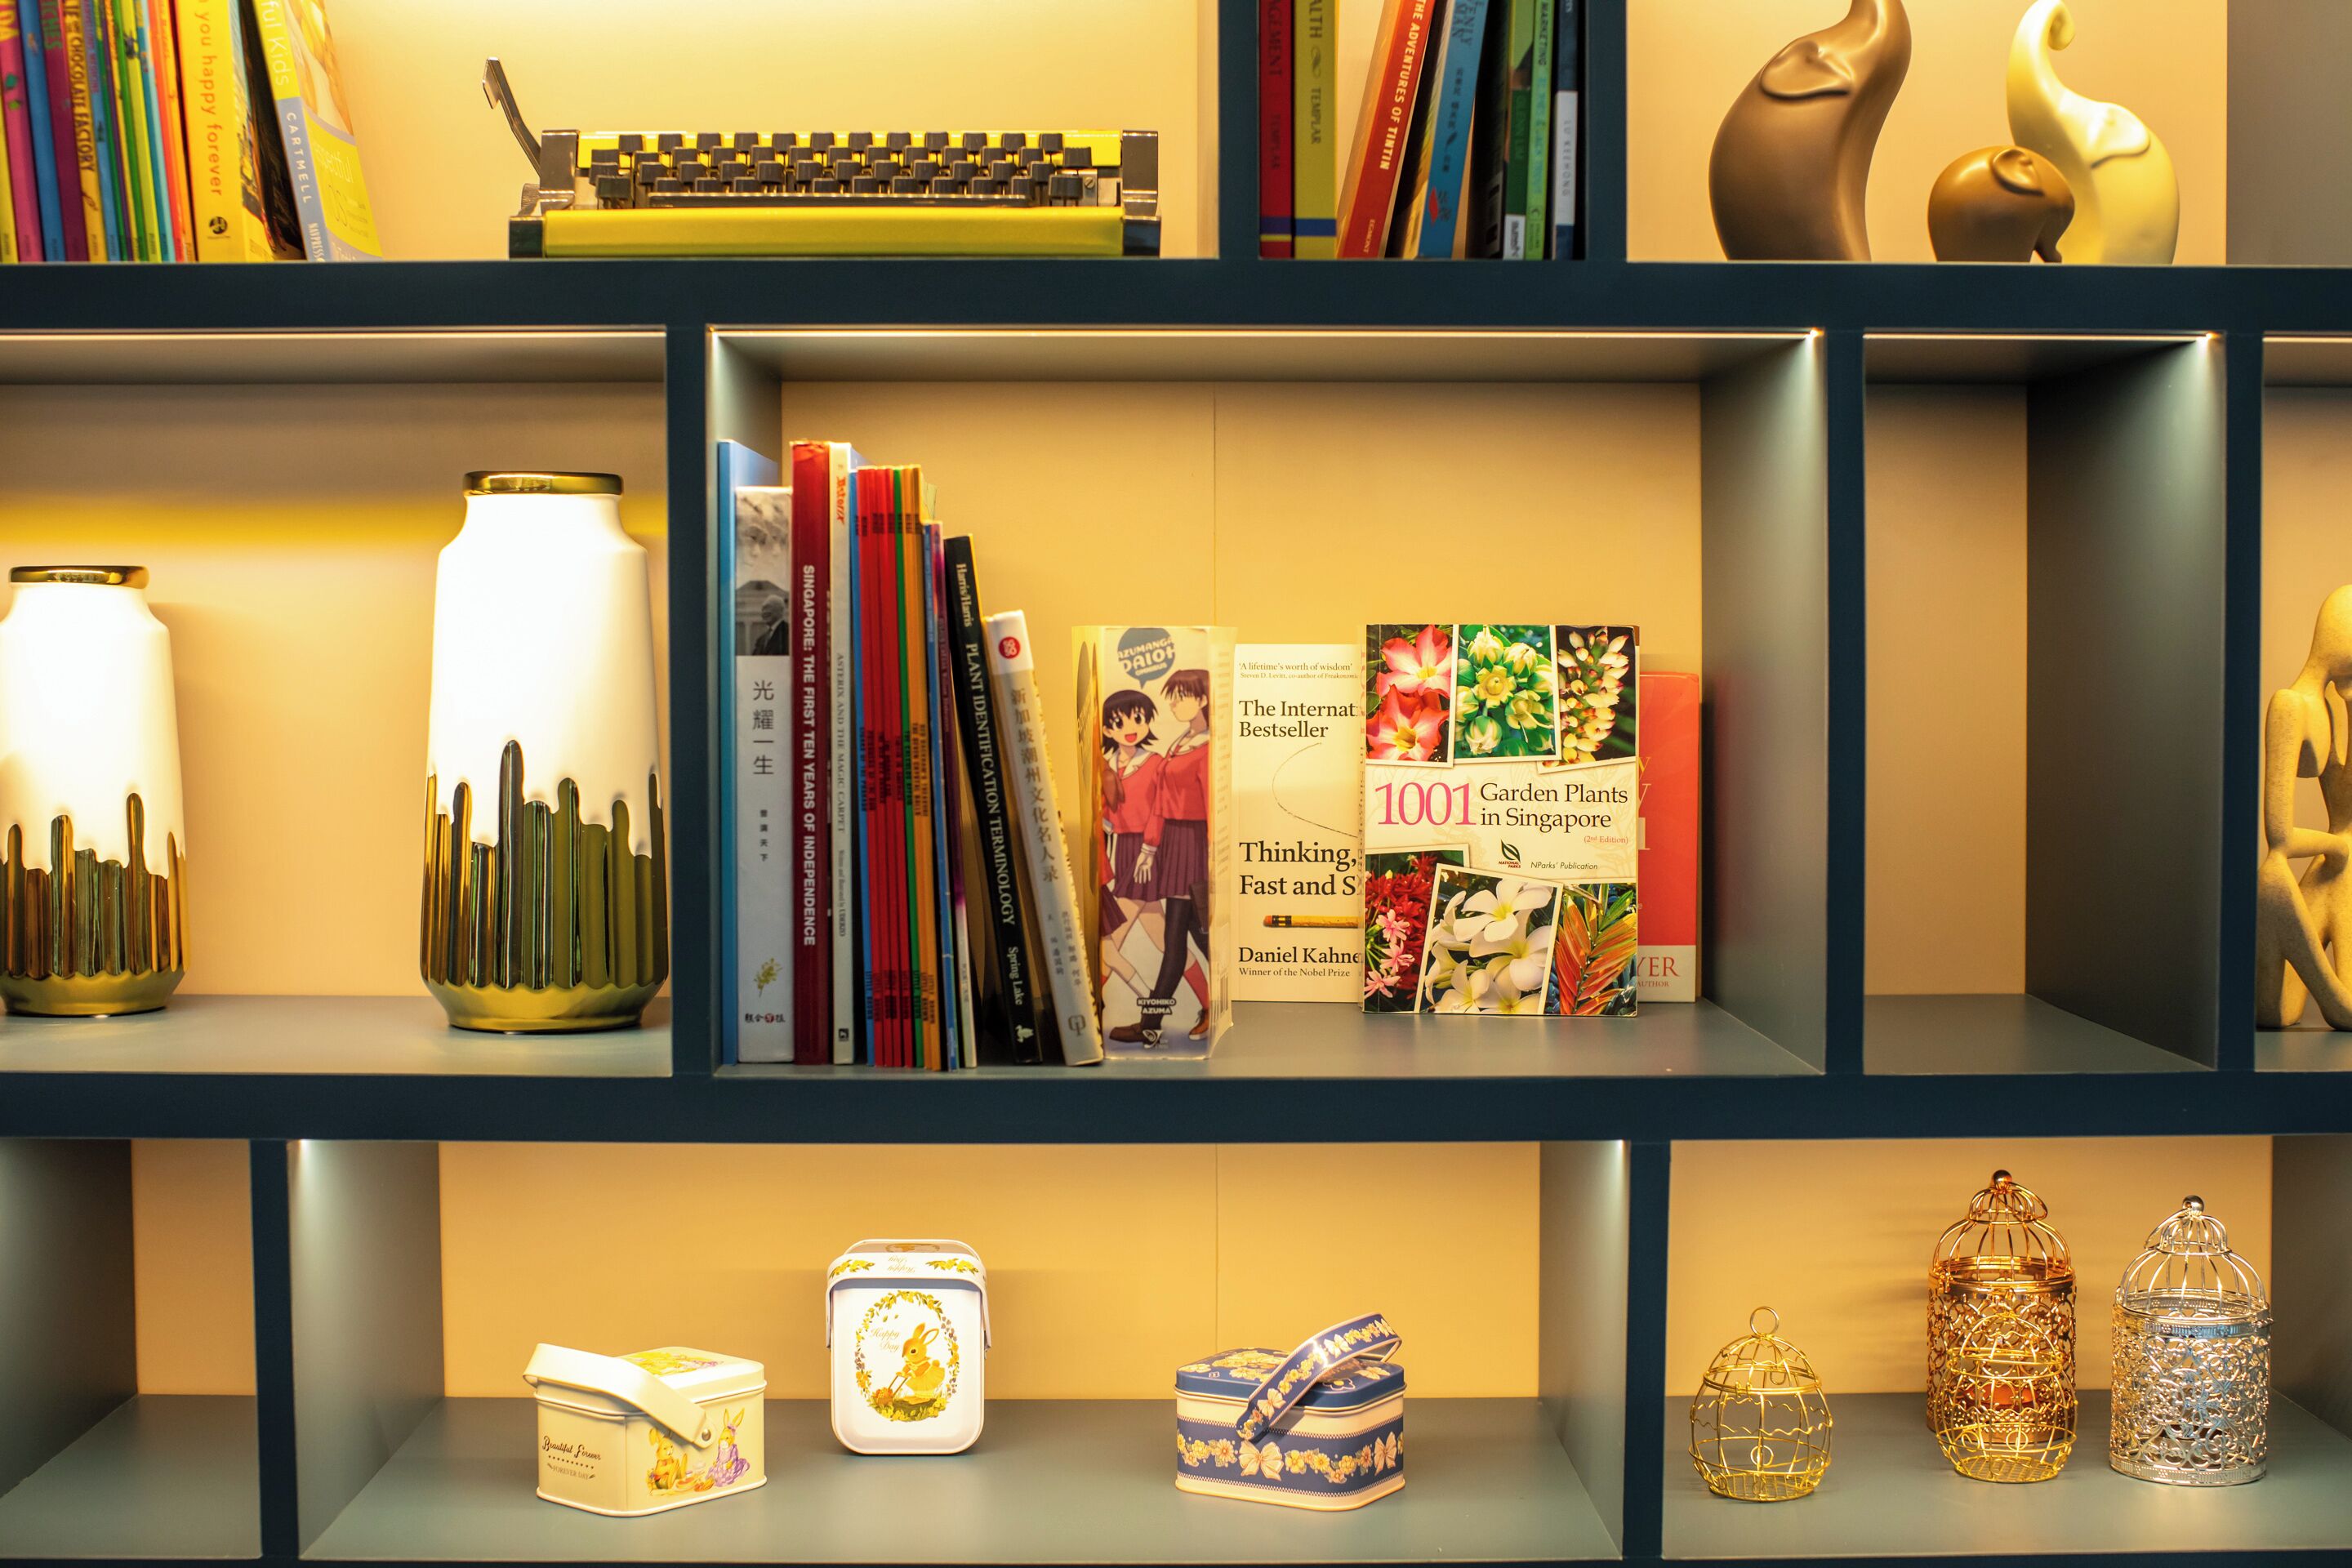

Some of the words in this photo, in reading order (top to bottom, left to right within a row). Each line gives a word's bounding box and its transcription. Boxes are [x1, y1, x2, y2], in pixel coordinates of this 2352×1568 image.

[260, 1, 282, 29] ful
[1413, 0, 1427, 20] THE
[194, 11, 212, 47] you
[1537, 2, 1549, 65] MARKETING
[70, 37, 87, 108] CHOCOLATE
[267, 38, 290, 87] Kids
[1395, 22, 1421, 104] ADVENTURES
[199, 55, 219, 115] happy
[1311, 87, 1321, 145] TEMPLAR
[1390, 106, 1403, 123] OF
[74, 113, 96, 172] FACTORY
[204, 123, 223, 196] forever
[286, 112, 312, 203] CARTMELL
[1379, 127, 1398, 171] TINTIN
[1363, 219, 1377, 254] EGMONT
[803, 564, 816, 651] SINGAPORE:
[956, 563, 973, 628] Harris/Harris
[804, 655, 816, 683] THE
[836, 653, 845, 697] ASTERIX
[965, 643, 984, 692] PLANT
[1249, 662, 1284, 670] lifetime's
[1310, 662, 1320, 670] of
[804, 686, 816, 727] FIRST
[837, 701, 845, 724] AND
[1239, 699, 1276, 717] The
[1281, 701, 1358, 717] Internat
[752, 679, 774, 775] 光耀一生
[837, 728, 845, 750] THE
[1240, 719, 1329, 737] Bestseller
[804, 731, 816, 758] TEN
[972, 695, 999, 814] IDENTIFICATION
[804, 763, 816, 809] YEARS
[837, 753, 845, 787] MAGIC
[837, 791, 845, 833] CARPET
[1375, 782, 1477, 827] 1001
[1480, 782, 1558, 802] Garden
[1565, 783, 1628, 804] Plants
[1481, 807, 1500, 826] in
[1506, 807, 1611, 833] Singapore
[804, 813, 816, 831] OF
[1239, 840, 1356, 872] Thinking,
[1599, 835, 1628, 844] Edition)
[987, 817, 1015, 925] TERMINOLOGY
[1560, 862, 1598, 870] Publication
[804, 836, 816, 946] INDEPENDENCE
[1240, 875, 1287, 895] Fast
[1293, 874, 1337, 895] and
[1006, 947, 1021, 978] Spring
[1239, 947, 1298, 963] Daniel
[1239, 967, 1272, 976] Winner
[1273, 967, 1283, 976] of
[1284, 967, 1298, 977] the
[1300, 968, 1325, 977] Nobel
[1328, 968, 1351, 977] Prize
[1011, 981, 1023, 1005] Lake
[871, 1328, 900, 1340] Happy
[880, 1341, 899, 1353] Day
[542, 1435, 573, 1454] Beautiful
[574, 1444, 601, 1460] Forever
